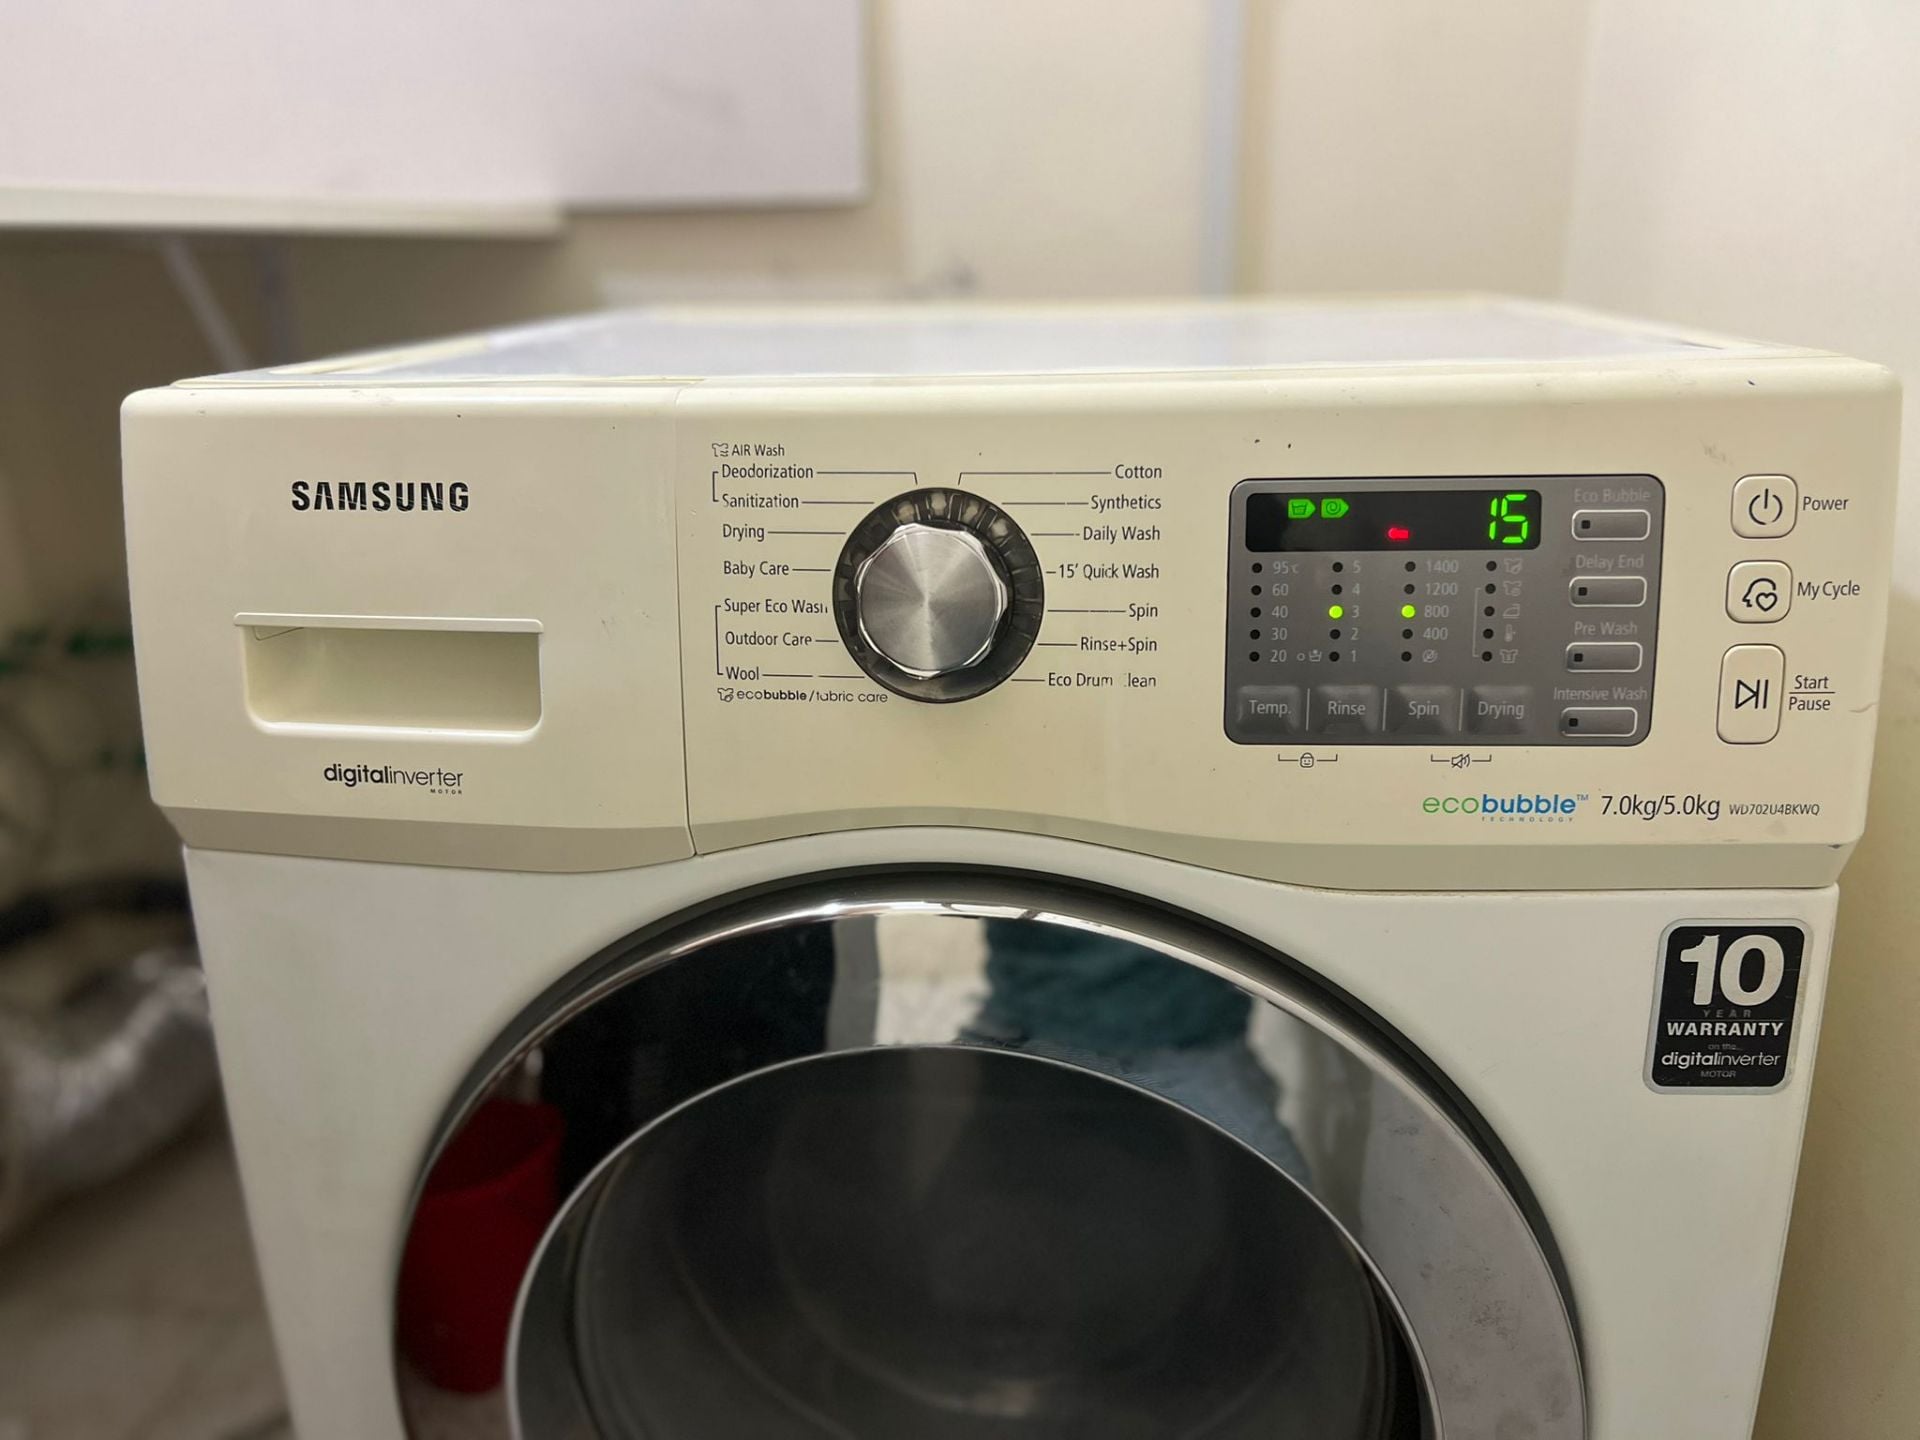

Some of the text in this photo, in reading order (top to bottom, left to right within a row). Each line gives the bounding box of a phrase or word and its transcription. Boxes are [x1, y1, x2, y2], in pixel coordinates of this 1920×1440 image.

[732, 444, 785, 456] AIR Wash
[722, 464, 814, 478] Deodorization
[1115, 464, 1162, 479] Cotton
[291, 480, 468, 512] SAMSUNG
[722, 494, 799, 508] Sanitization
[1574, 488, 1650, 502] Eco Bubble
[1091, 495, 1162, 513] Synthetics
[1802, 496, 1849, 511] Power
[1489, 494, 1528, 544] 15
[722, 524, 765, 542] Drying
[1083, 526, 1160, 544] Daily Wash
[724, 561, 790, 578] Baby Care
[1352, 560, 1361, 574] 5
[1424, 560, 1459, 574] 1400
[1575, 554, 1644, 572] Delay End
[1083, 564, 1119, 580] Quick
[1122, 564, 1160, 578] Wash
[1272, 584, 1288, 596] 60
[1351, 583, 1360, 596] 4
[1424, 583, 1458, 596] 1200
[1797, 580, 1860, 600] My Cycle
[724, 598, 760, 618] Super
[765, 599, 788, 613] Eco
[1129, 602, 1158, 621] Spin
[1271, 606, 1288, 618] 40
[1351, 606, 1360, 618] 3
[1424, 606, 1450, 618] 800
[1271, 628, 1288, 640] 30
[1350, 628, 1359, 640] 2
[1422, 628, 1448, 640] 400
[1574, 621, 1638, 635] Pre Wash
[725, 631, 812, 646] Outdoor Care
[1080, 636, 1158, 655] Rinse+Spin
[1270, 650, 1287, 662] 20
[1351, 650, 1358, 662] 1
[726, 666, 760, 680] Wool
[1048, 672, 1157, 688] Eco Drum lean
[1794, 675, 1829, 690] Start
[858, 692, 888, 703] care
[1554, 686, 1648, 700] Intensive Wash
[1249, 700, 1292, 719] Temp.
[1328, 700, 1366, 716] Rinse
[1408, 700, 1440, 720] Spin
[1478, 700, 1524, 720] Drying
[1788, 697, 1831, 711] Pause
[324, 764, 463, 788] digitalinverter
[1601, 794, 1721, 821] 7.0kg/5.0kg
[1728, 804, 1820, 816] WD702U4BKWQ
[1680, 934, 1785, 1006] 10
[1703, 1009, 1752, 1018] YEAR
[1666, 1022, 1784, 1036] WARRANTY
[1661, 1052, 1781, 1069] digitalinverter
[1700, 1070, 1737, 1078] MOTOR
